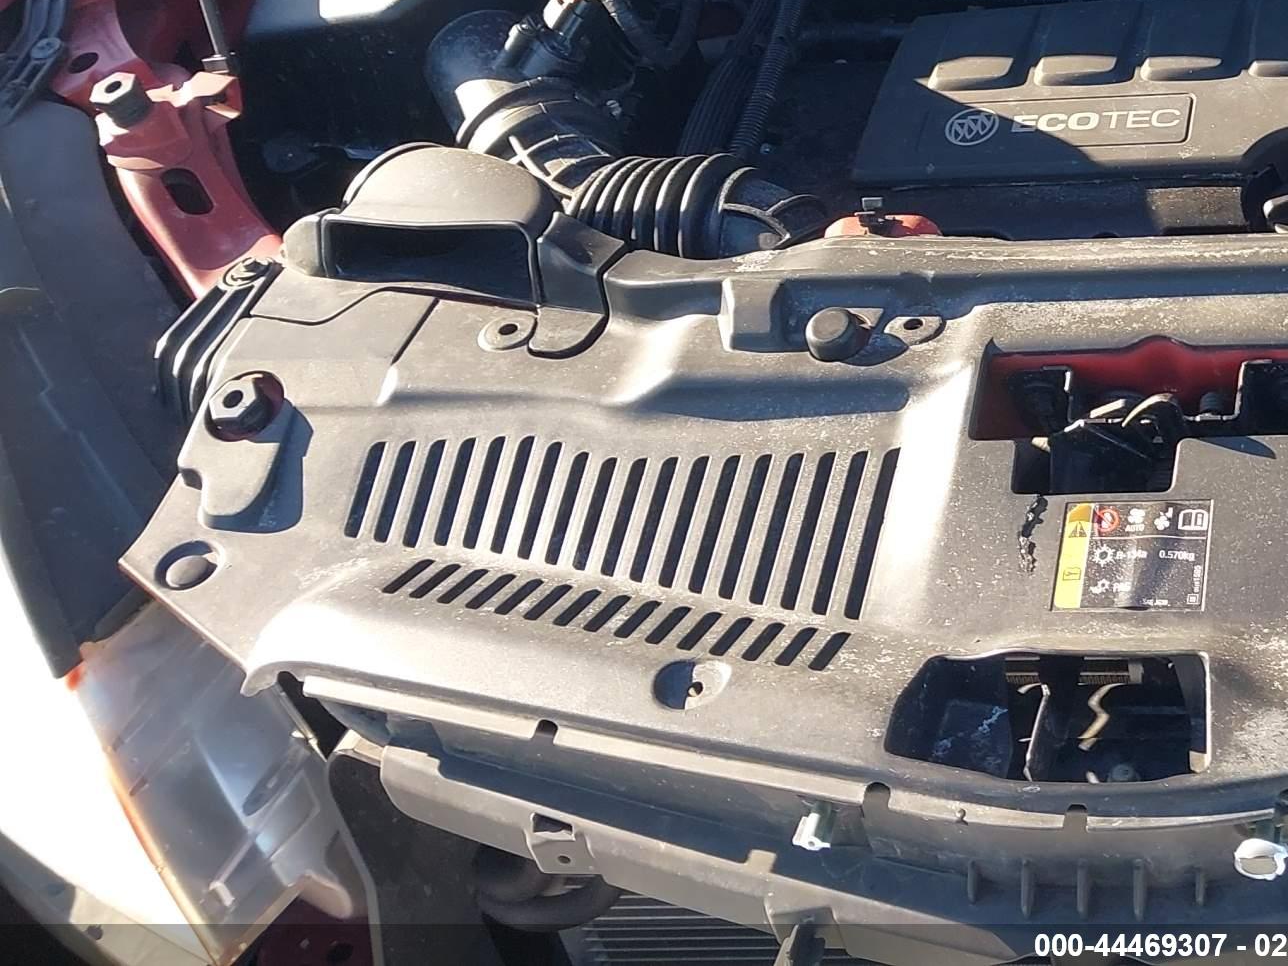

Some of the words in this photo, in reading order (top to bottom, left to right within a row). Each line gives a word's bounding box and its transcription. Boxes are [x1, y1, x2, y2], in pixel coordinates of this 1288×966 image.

[1011, 109, 1181, 133] ECOTEC
[1125, 524, 1145, 532] AUTO
[1159, 549, 1195, 562] 0.570kg
